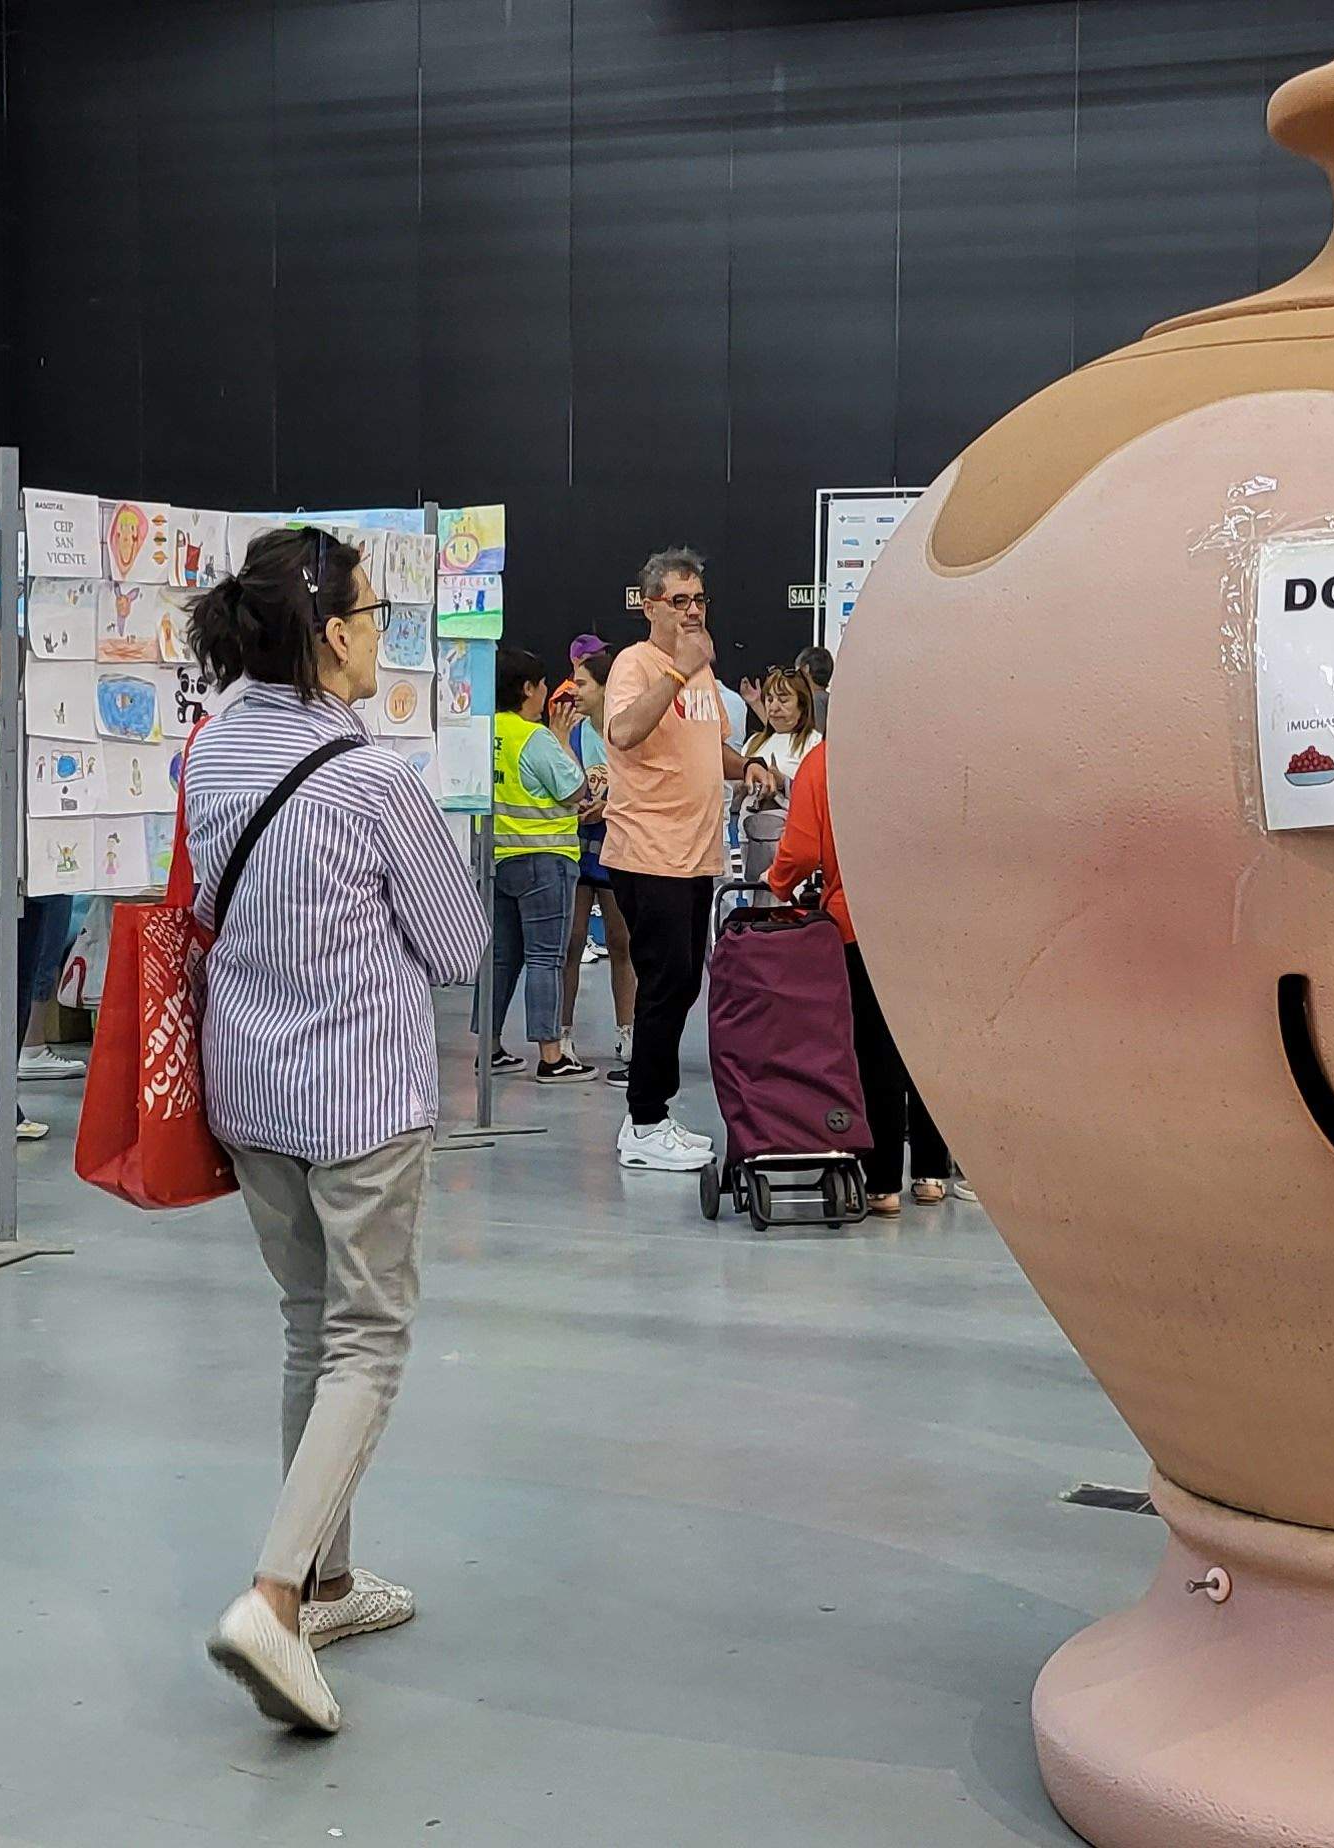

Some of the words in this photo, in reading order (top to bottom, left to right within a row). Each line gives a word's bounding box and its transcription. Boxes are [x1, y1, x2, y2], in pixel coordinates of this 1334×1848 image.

[53, 521, 74, 533] CEIP
[55, 536, 74, 548] SAN
[47, 552, 87, 565] VICENTE
[791, 588, 828, 604] SALIA
